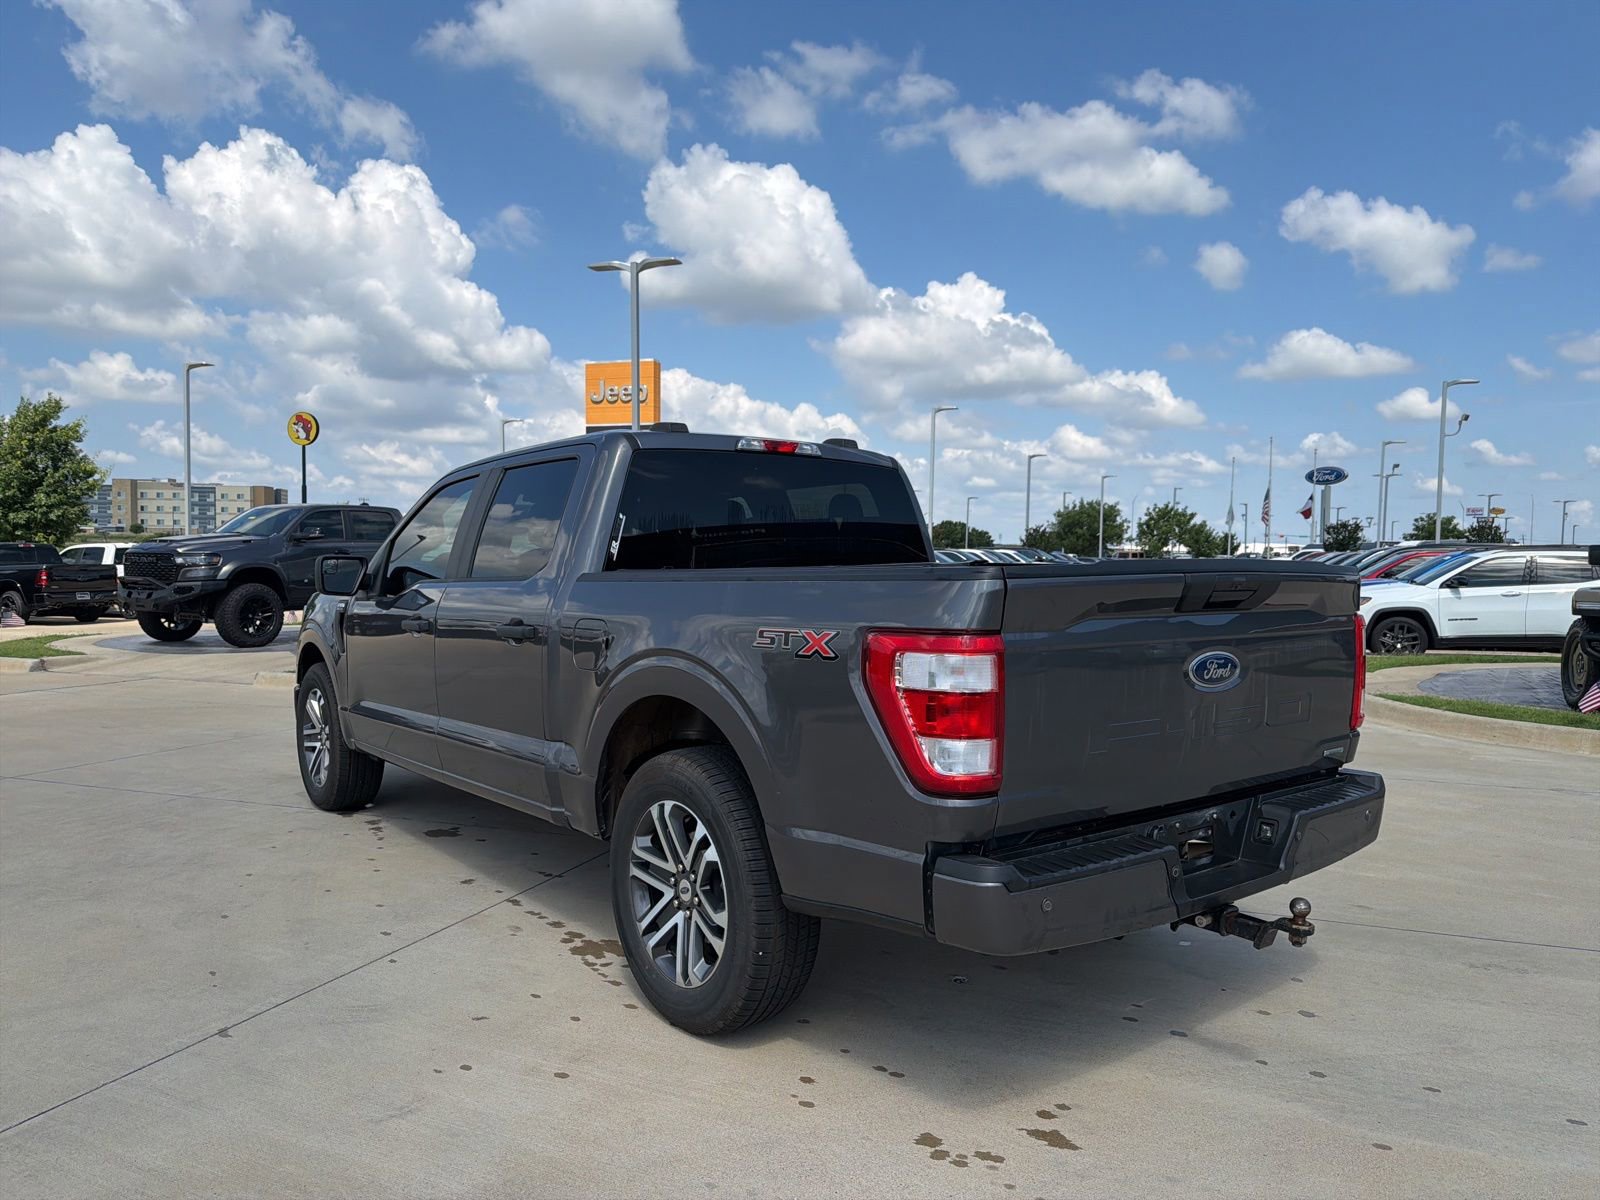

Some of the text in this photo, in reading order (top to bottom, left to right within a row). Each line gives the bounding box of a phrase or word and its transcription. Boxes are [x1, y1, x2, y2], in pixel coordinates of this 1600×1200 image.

[1313, 470, 1337, 481] Ford
[752, 628, 841, 662] STX
[1204, 659, 1231, 680] Ford
